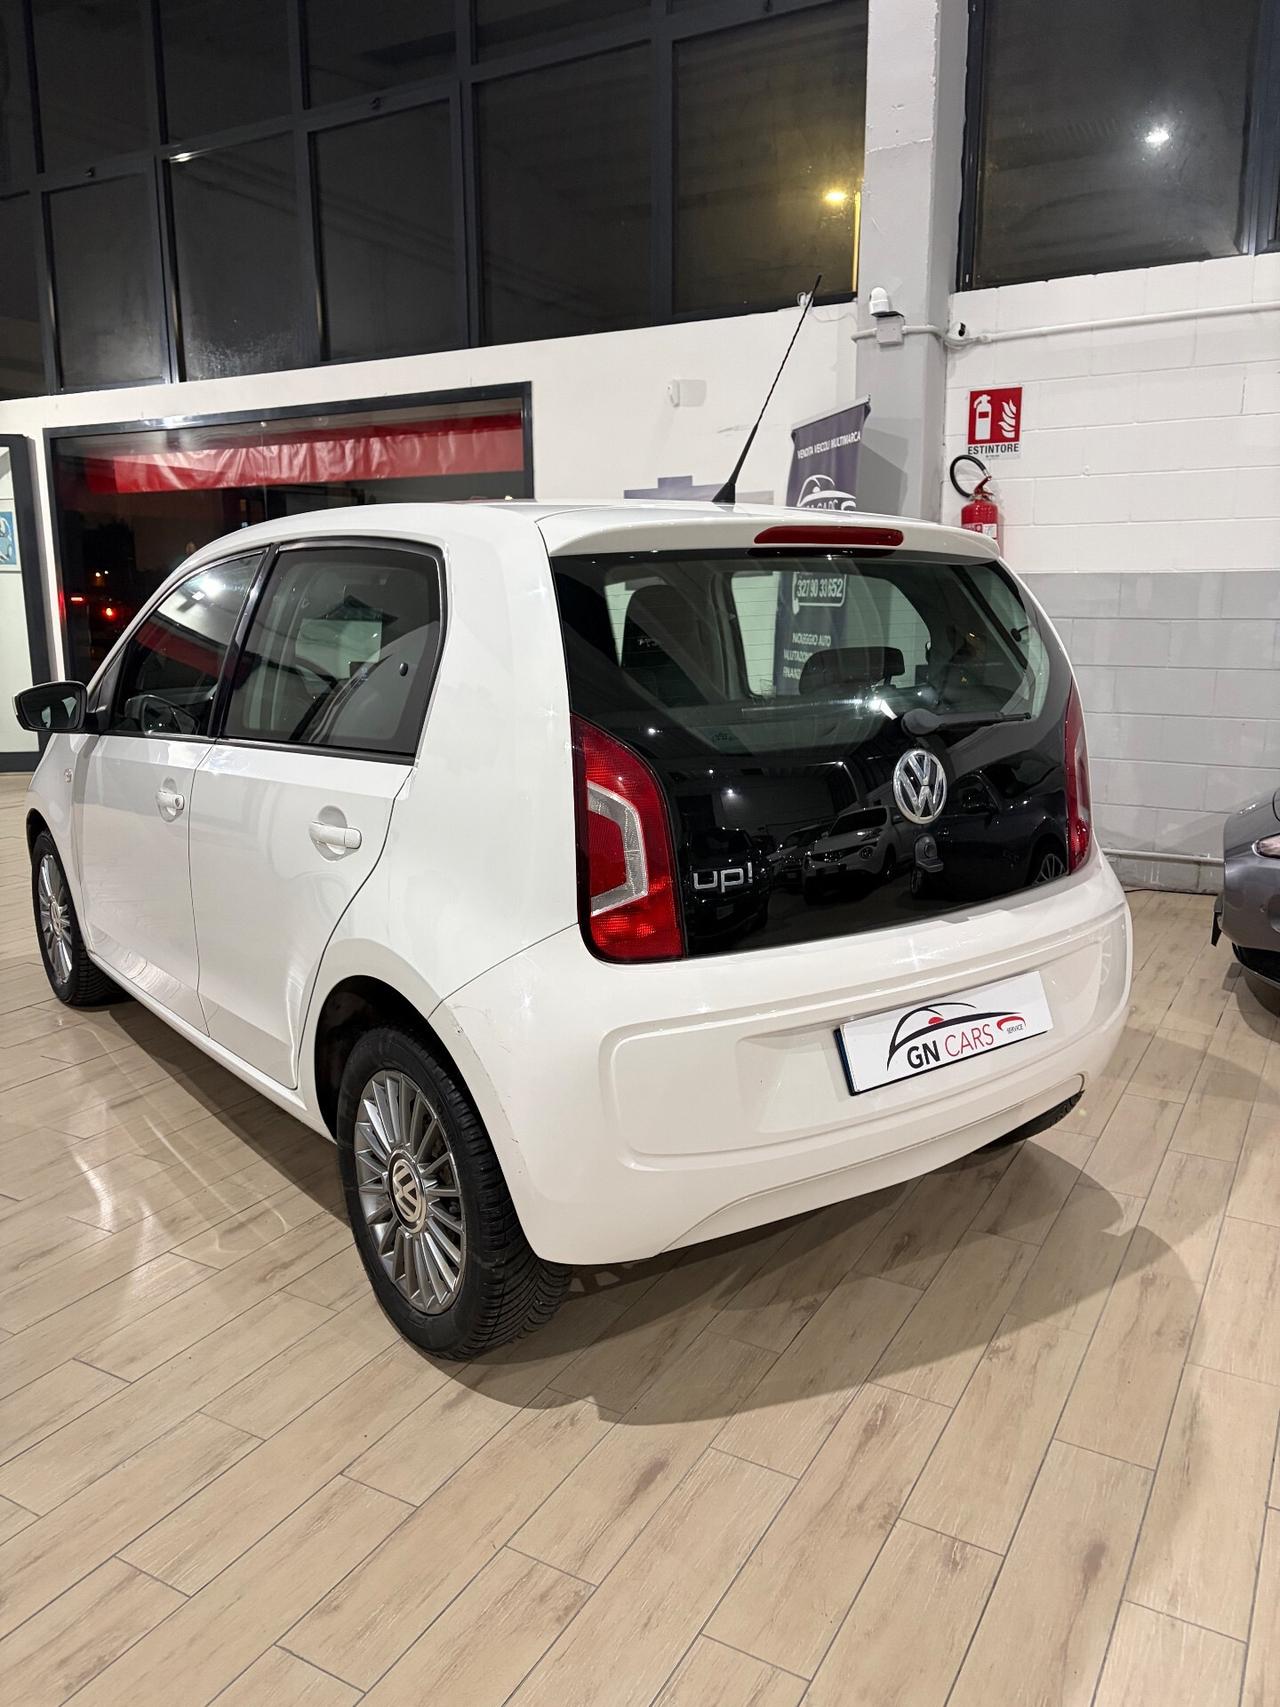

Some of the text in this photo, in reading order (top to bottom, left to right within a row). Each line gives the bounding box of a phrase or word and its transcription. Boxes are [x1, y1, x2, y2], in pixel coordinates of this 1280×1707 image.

[830, 430, 861, 448] MULTIMARCA
[967, 443, 1019, 456] ESTINTORE
[693, 861, 753, 893] up!
[906, 1023, 994, 1069] GN CARS
